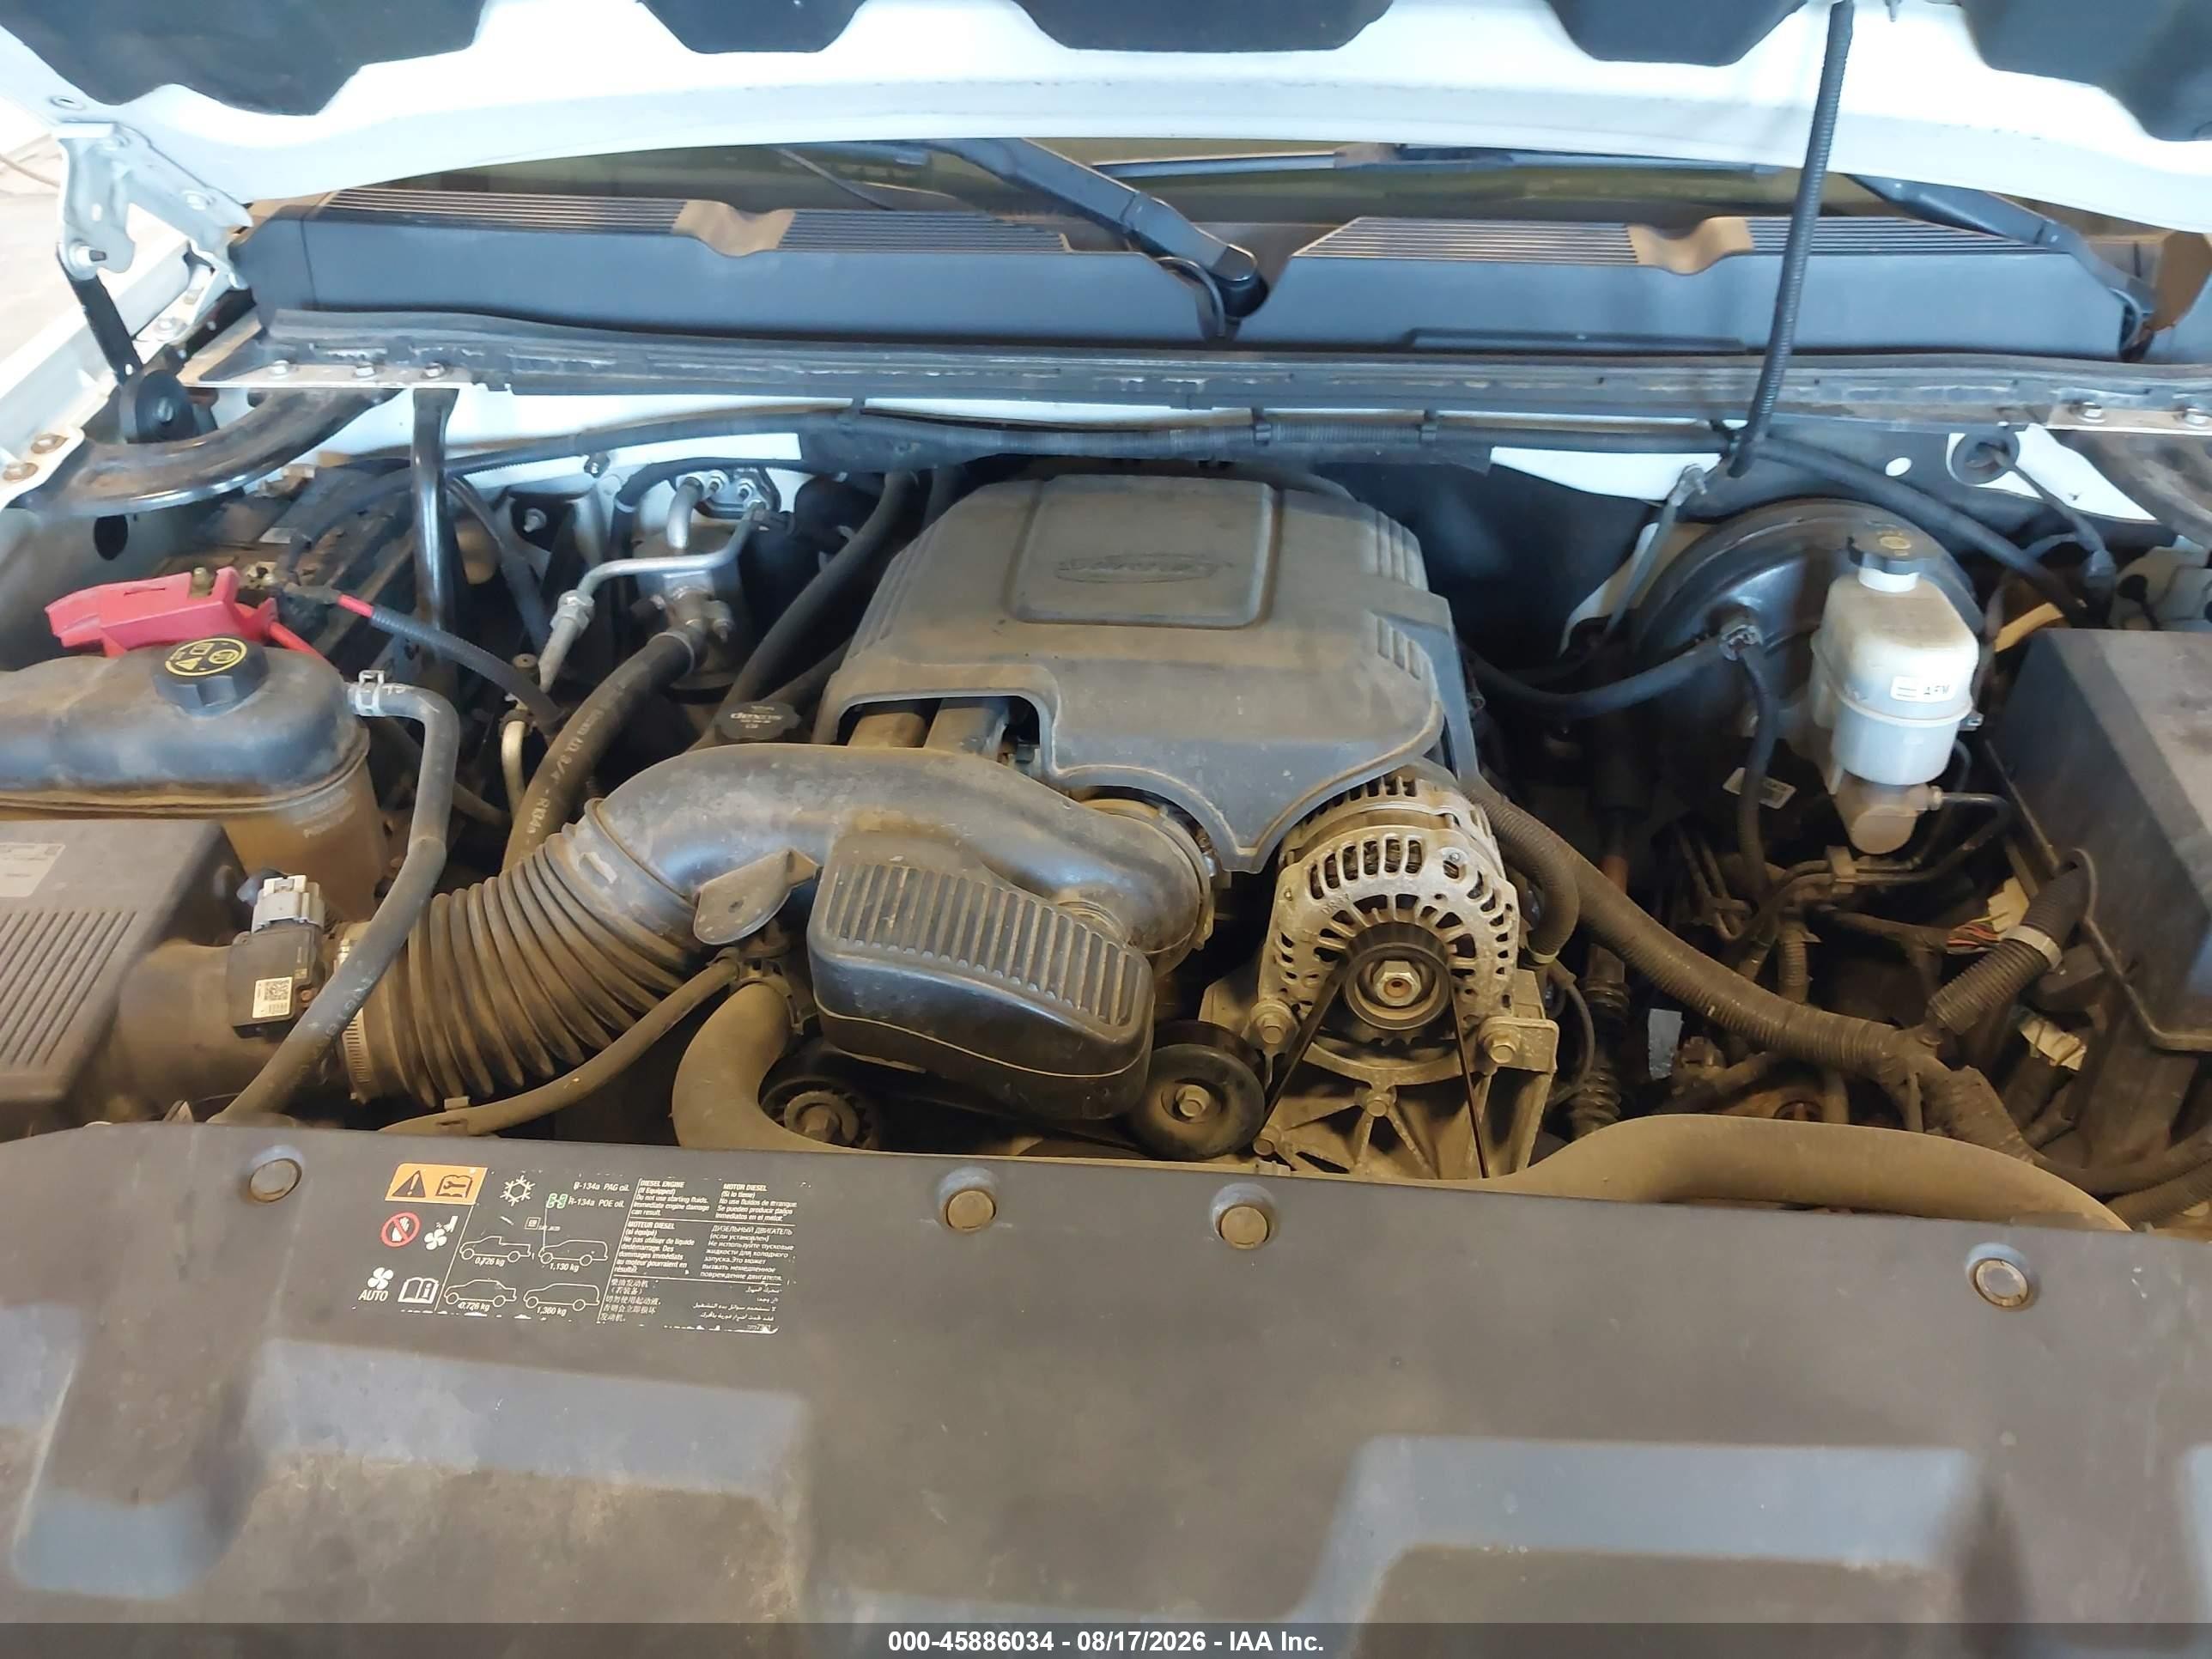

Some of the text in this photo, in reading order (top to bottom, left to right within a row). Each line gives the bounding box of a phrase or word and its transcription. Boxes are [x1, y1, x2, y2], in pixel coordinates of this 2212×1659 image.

[568, 1196, 595, 1206] R-134a
[599, 1199, 614, 1207] POE
[754, 1226, 793, 1236] ДВИГАТЕЛЬ
[495, 1258, 505, 1267] kg
[569, 1264, 580, 1273] kg
[357, 1289, 389, 1302] AUTO
[480, 1303, 490, 1311] kg
[537, 1306, 556, 1316] 1,360
